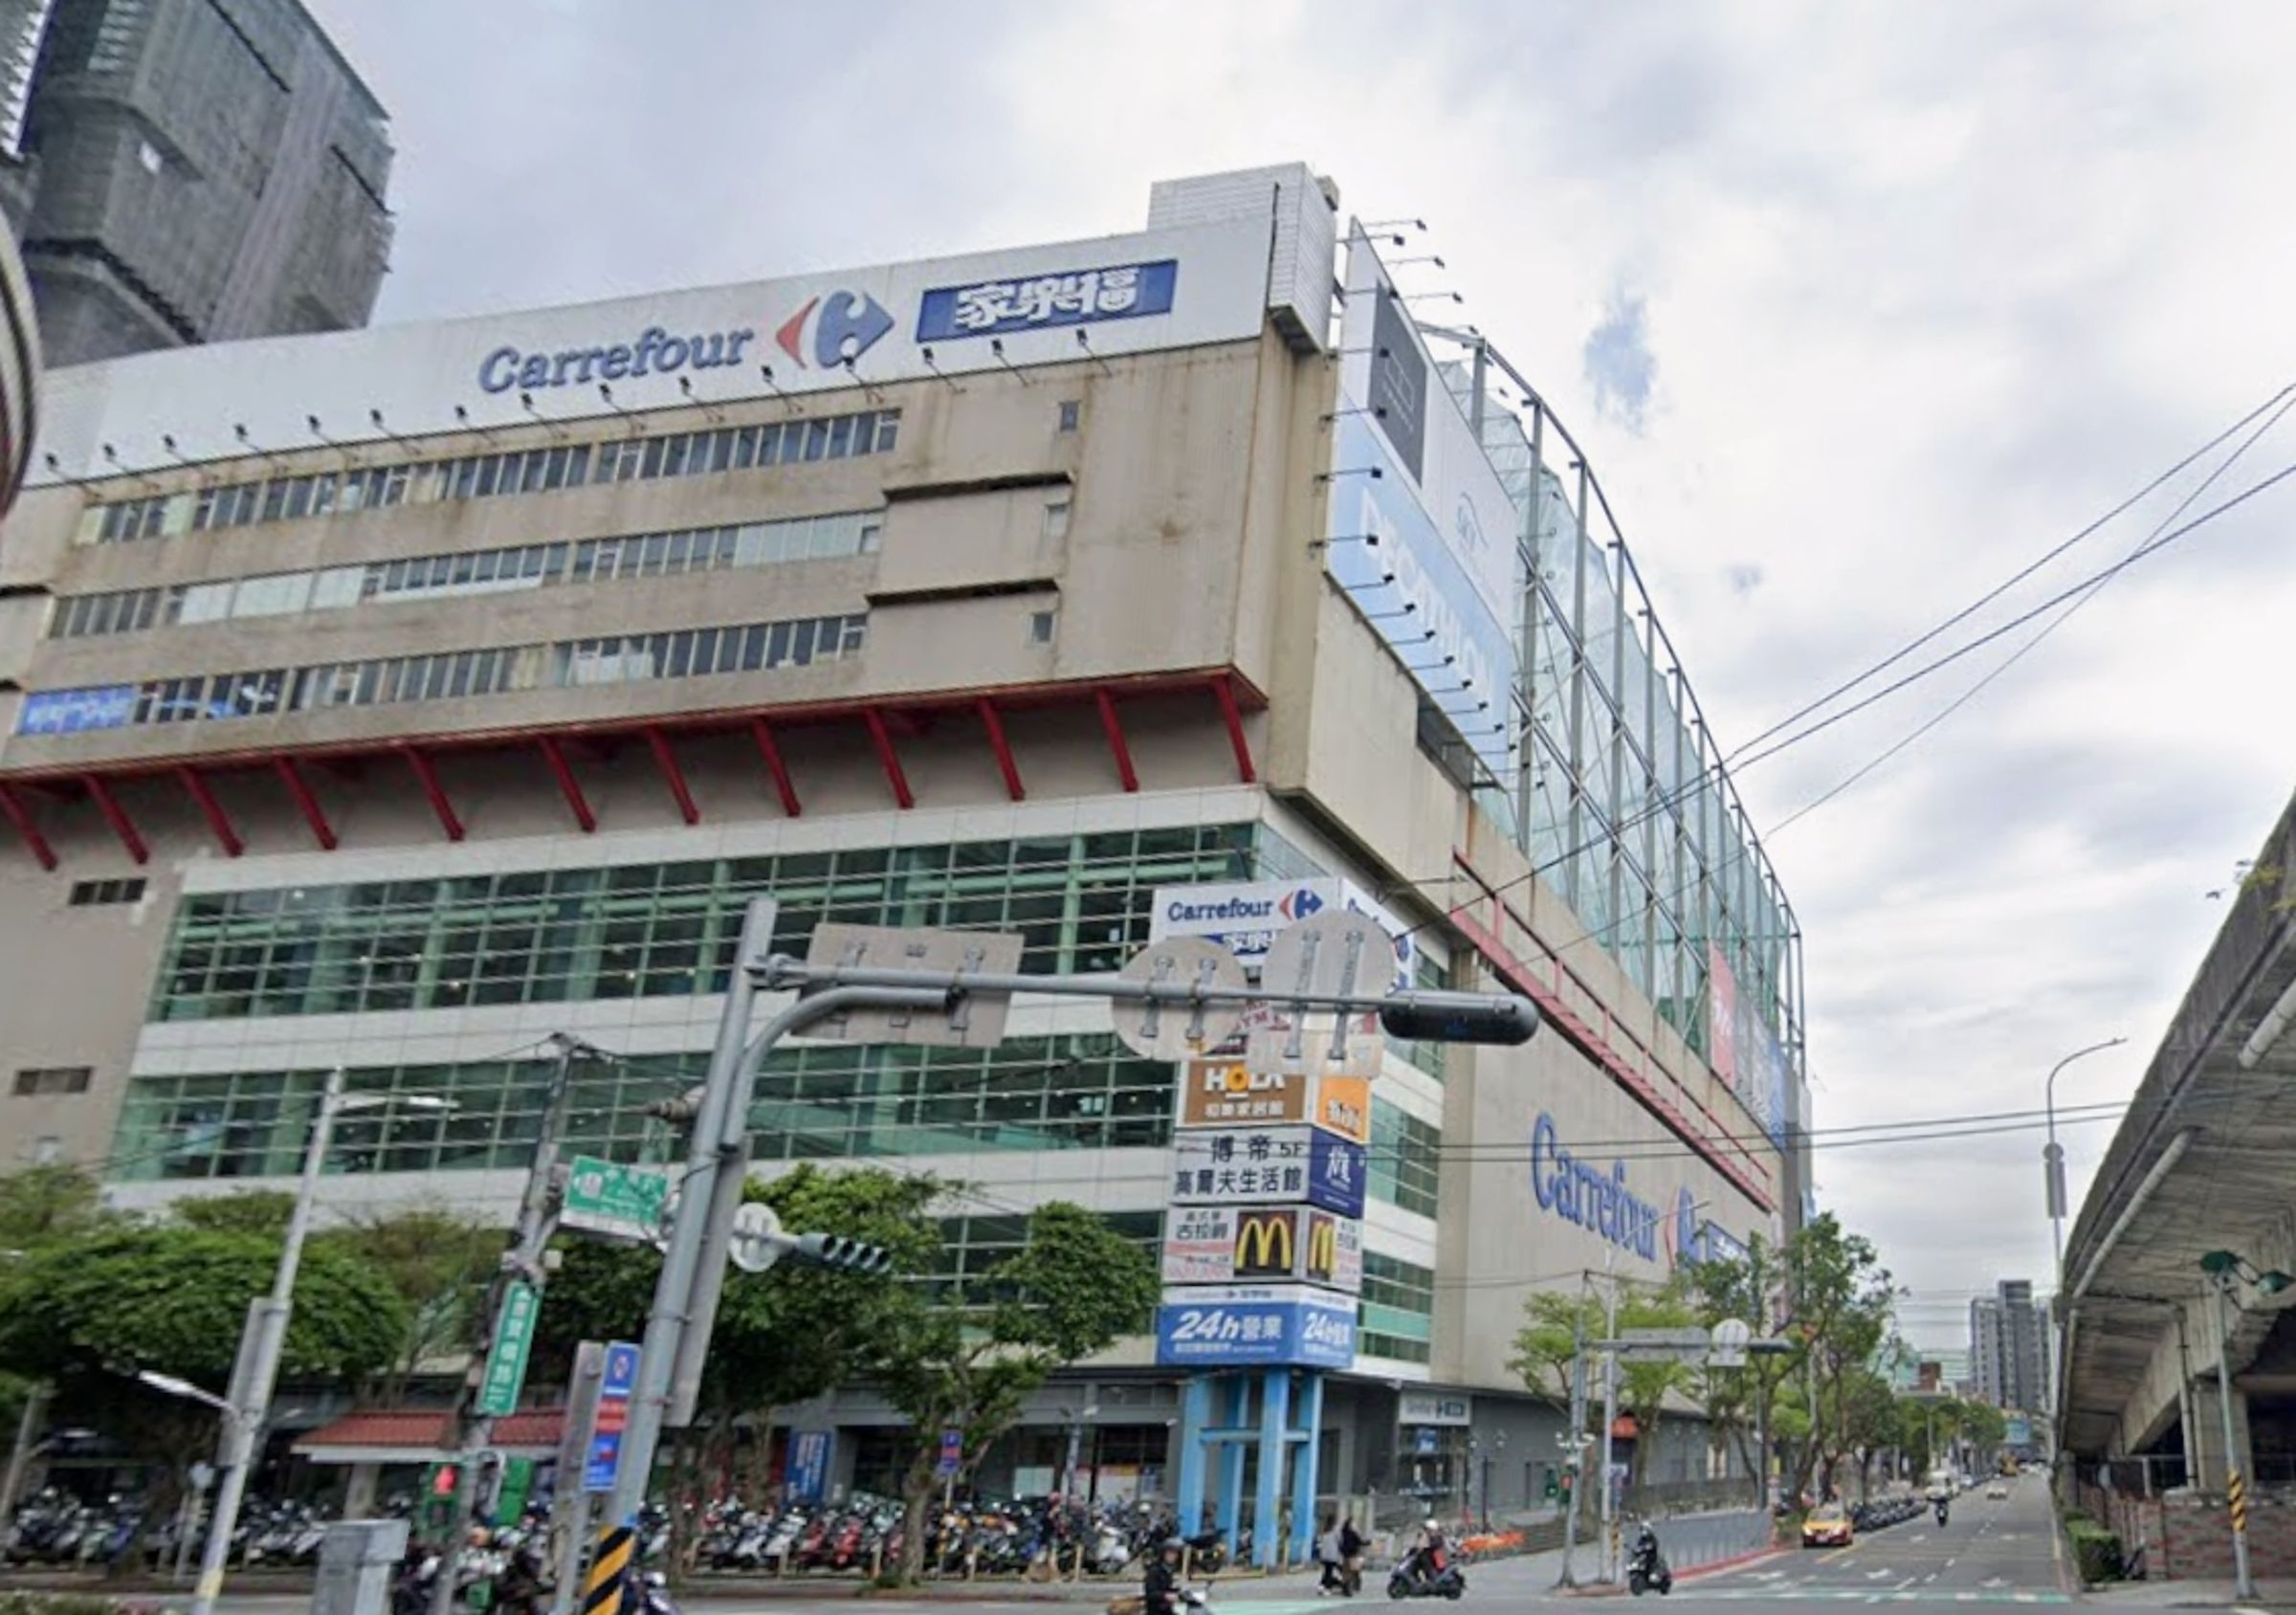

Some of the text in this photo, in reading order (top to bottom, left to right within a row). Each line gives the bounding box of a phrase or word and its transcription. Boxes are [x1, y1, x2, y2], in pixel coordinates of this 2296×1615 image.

[478, 327, 755, 395] Carrefour
[1167, 897, 1274, 921] Carrefour
[1532, 1111, 1659, 1263] Carrefour
